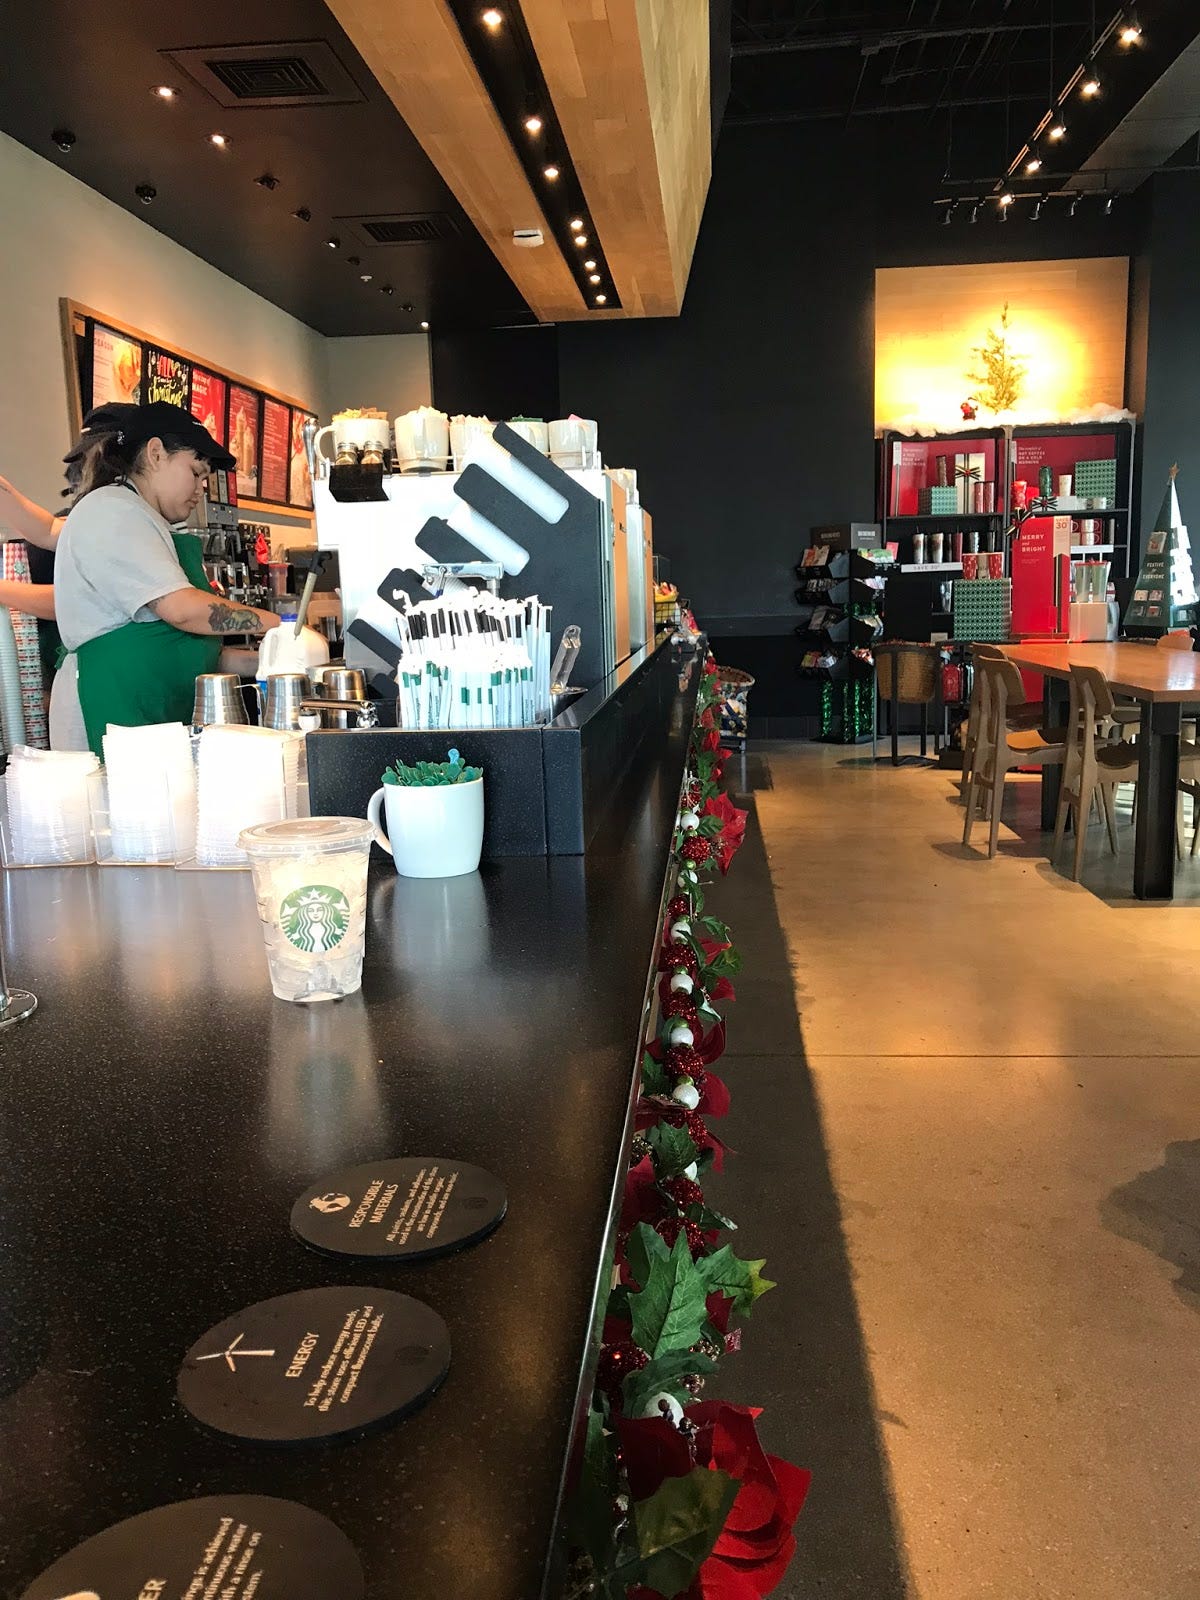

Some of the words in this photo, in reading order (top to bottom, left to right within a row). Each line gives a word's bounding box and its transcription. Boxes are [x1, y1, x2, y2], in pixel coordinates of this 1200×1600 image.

[349, 1180, 385, 1228] RESPONSIBLE
[369, 1184, 399, 1223] MATERIALS
[353, 1318, 368, 1332] LED
[285, 1332, 320, 1377] ENERGY
[202, 1517, 234, 1564] achieved
[226, 1523, 248, 1553] water
[248, 1531, 263, 1547] on
